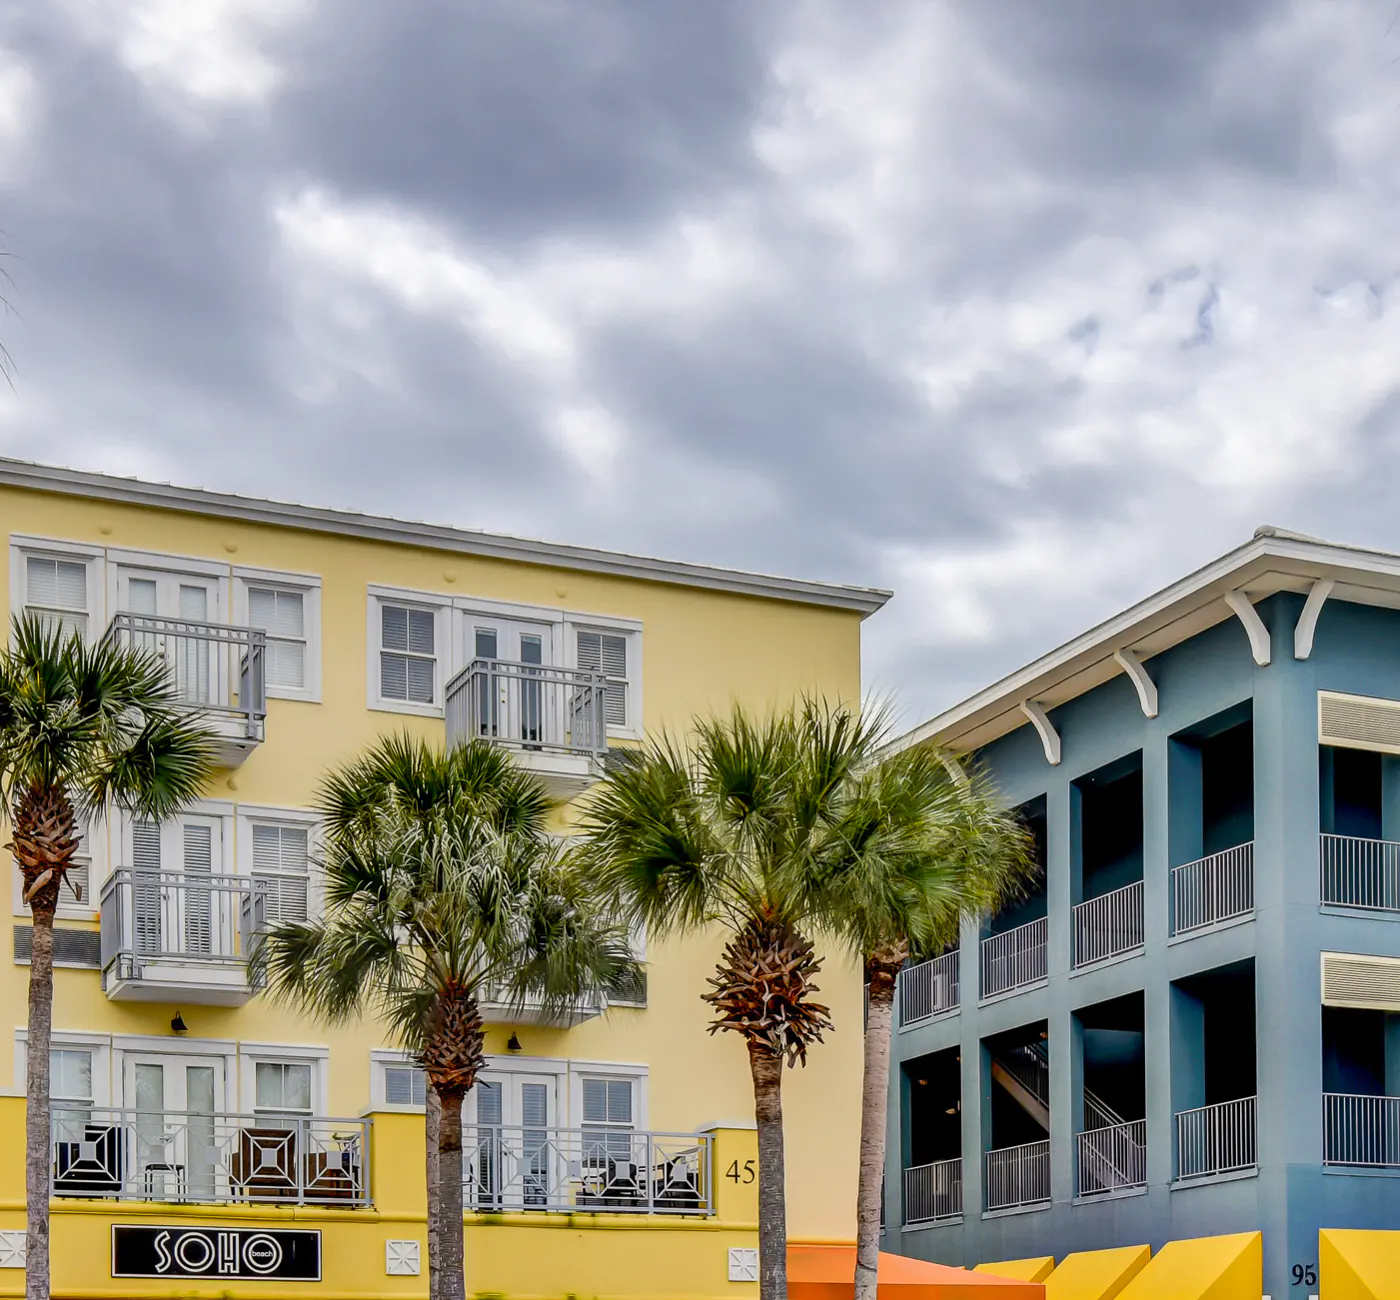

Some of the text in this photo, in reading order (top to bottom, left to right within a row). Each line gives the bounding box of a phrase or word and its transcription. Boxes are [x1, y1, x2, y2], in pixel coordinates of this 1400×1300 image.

[725, 1159, 756, 1184] 45
[154, 1231, 283, 1274] SOHO
[1291, 1263, 1317, 1286] 95
